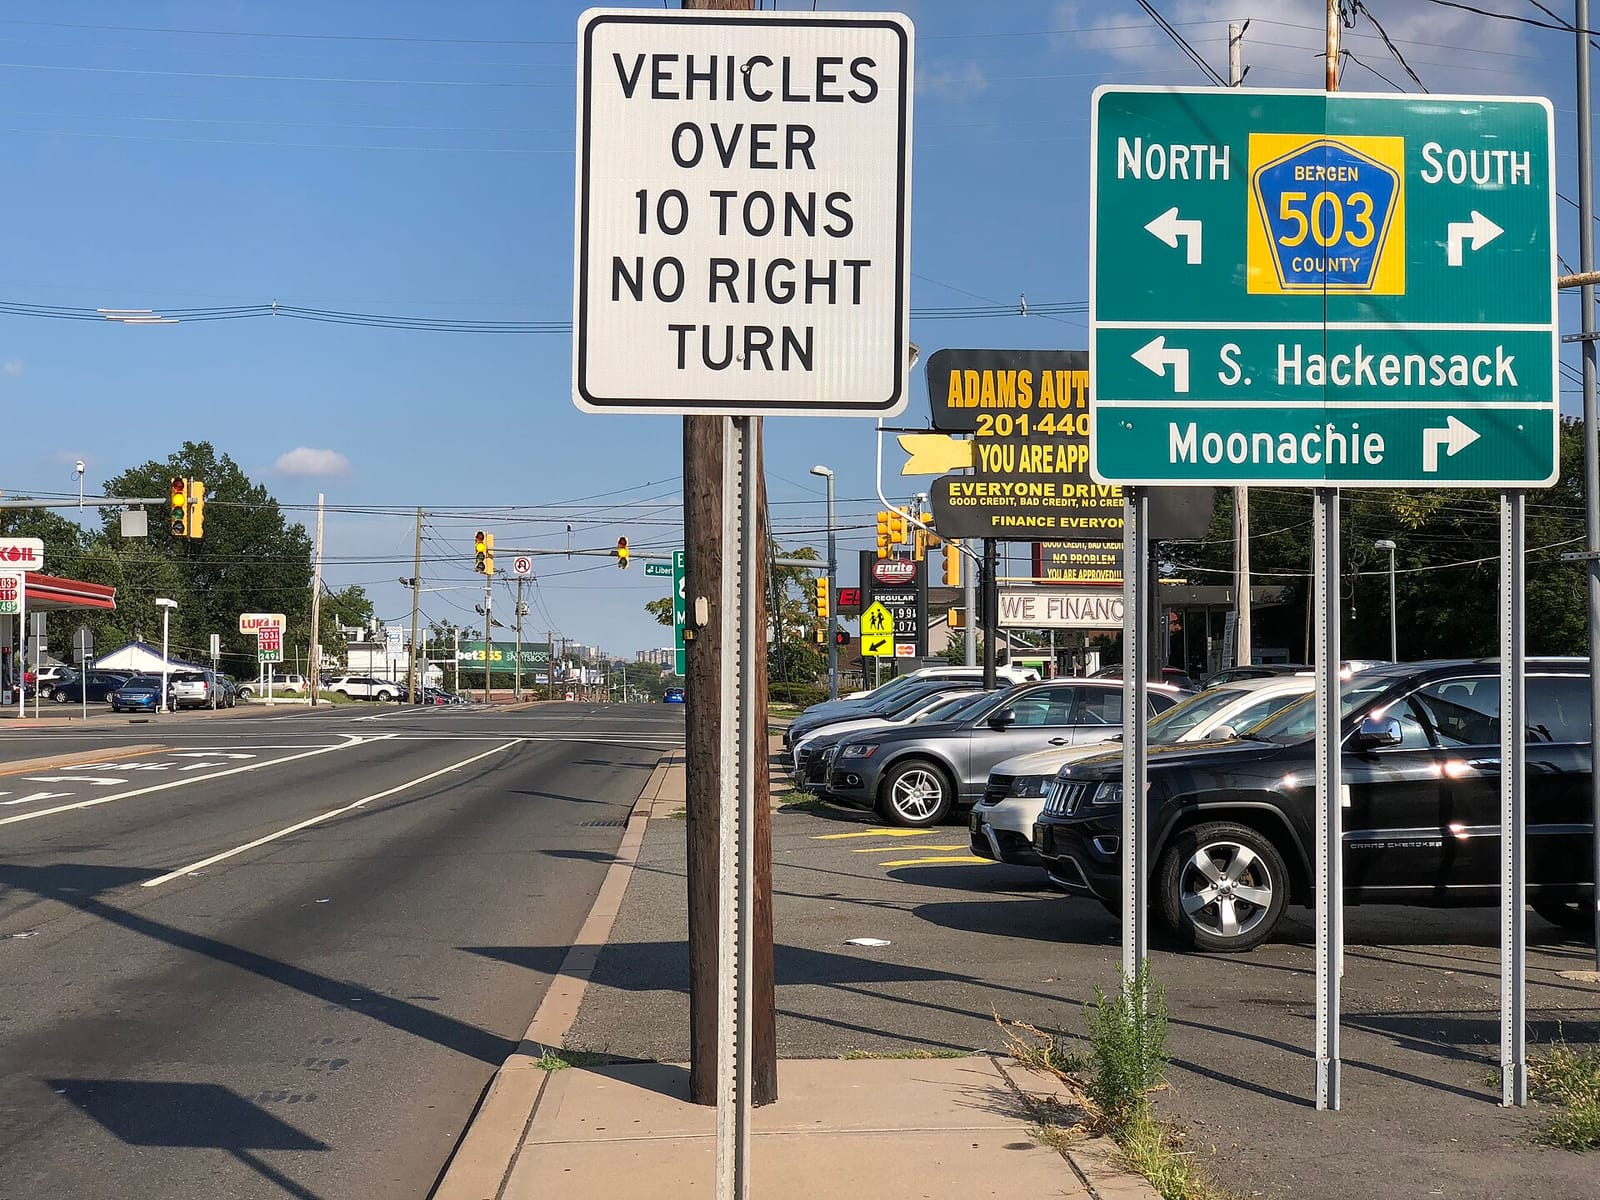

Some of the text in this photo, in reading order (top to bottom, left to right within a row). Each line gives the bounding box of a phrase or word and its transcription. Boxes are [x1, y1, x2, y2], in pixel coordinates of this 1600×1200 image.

[613, 53, 878, 103] VEHICLES
[671, 122, 816, 169] OVER
[1117, 136, 1230, 181] NORTH
[1420, 142, 1530, 185] SOUTH
[1294, 166, 1359, 181] BERGEN
[635, 189, 854, 238] 10 TONS
[1279, 191, 1376, 247] 503
[612, 256, 871, 305] NO RIGHT
[1292, 257, 1360, 272] COUNTY
[668, 324, 814, 372] TURN
[1218, 344, 1518, 387] S. Hackensack
[948, 370, 1089, 408] ADAMS AUT
[978, 444, 1015, 473] YOU
[1019, 445, 1053, 473] ARE
[1169, 422, 1385, 466] Moonachie
[949, 483, 1123, 497] EVERYONE DRIVE
[949, 498, 977, 506] GOOD
[980, 498, 1017, 507] CREDIT,
[1020, 498, 1040, 506] BAD
[1042, 498, 1079, 508] CREDIT,
[1081, 499, 1097, 507] NO
[992, 516, 1055, 527] FINANCE
[876, 562, 913, 574] Enrite
[1047, 568, 1061, 580] YOU
[1063, 569, 1076, 580] ARE
[1052, 553, 1116, 565] NO PROBLEM
[1001, 597, 1036, 619] WE
